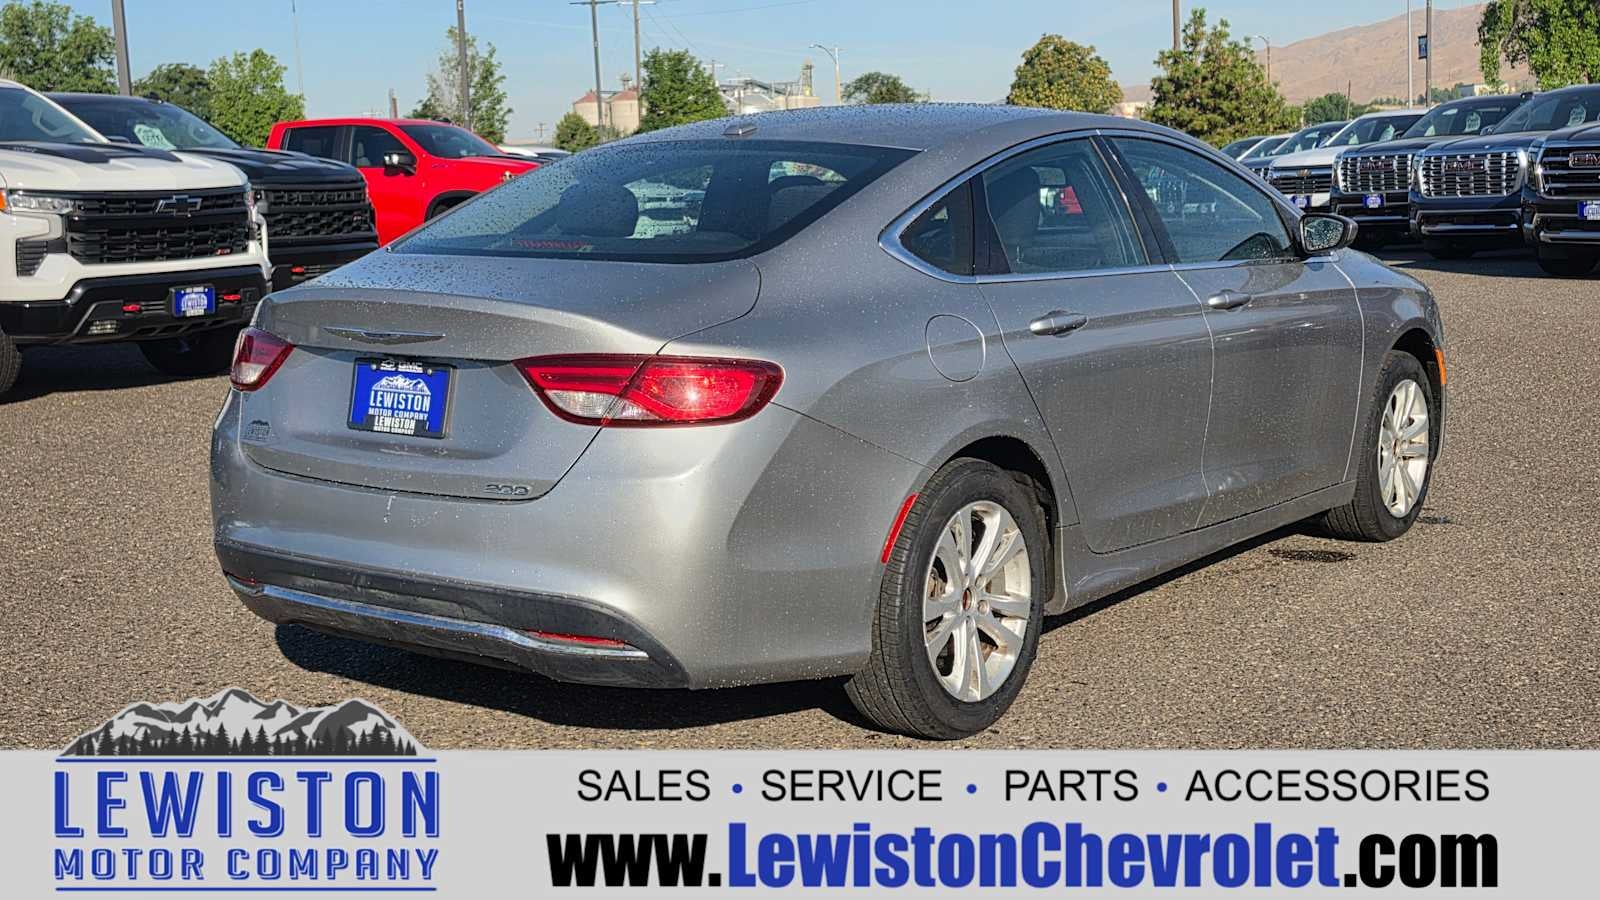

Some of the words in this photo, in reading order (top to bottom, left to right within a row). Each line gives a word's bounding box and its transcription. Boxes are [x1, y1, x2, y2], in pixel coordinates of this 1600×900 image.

[369, 390, 431, 412] LEWISTON
[368, 407, 393, 417] MOTOR
[394, 410, 429, 421] COMPANY
[374, 416, 416, 429] LEWISTON
